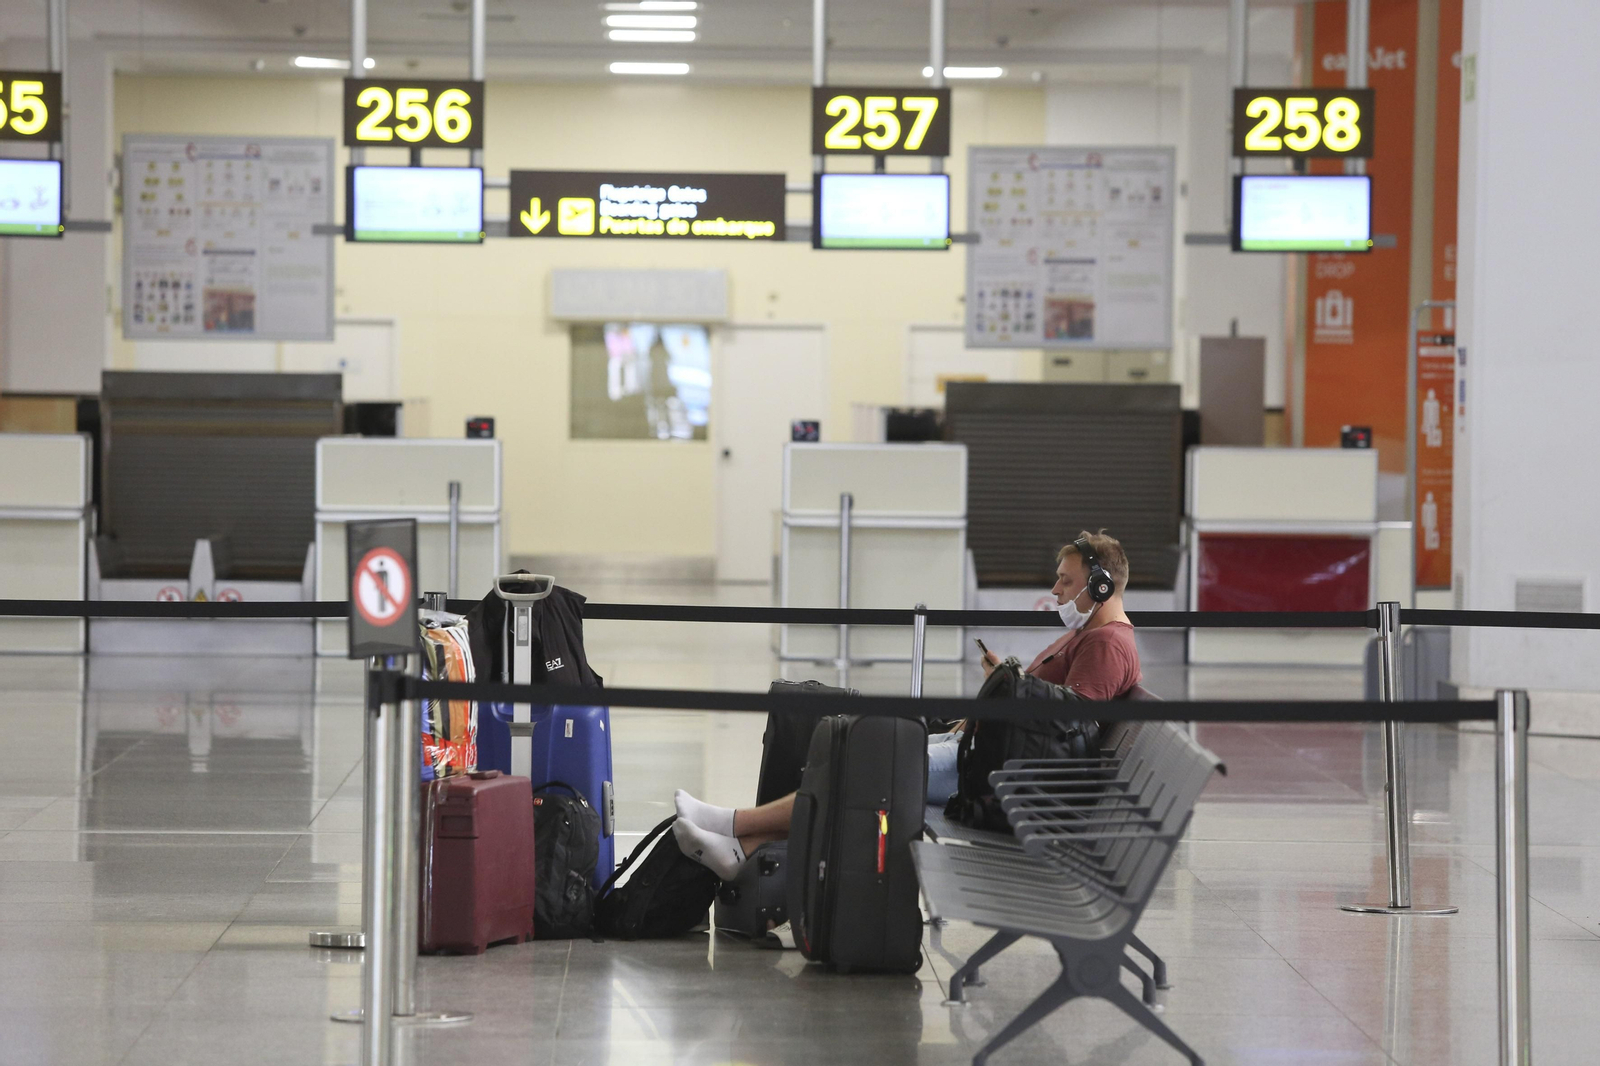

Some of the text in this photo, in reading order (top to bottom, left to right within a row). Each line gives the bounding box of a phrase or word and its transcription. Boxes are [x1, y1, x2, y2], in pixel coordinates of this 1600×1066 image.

[0, 80, 48, 135] 5
[356, 86, 472, 143] 256
[825, 95, 938, 150] 257
[1245, 97, 1361, 151] 258
[545, 657, 562, 669] EA7
